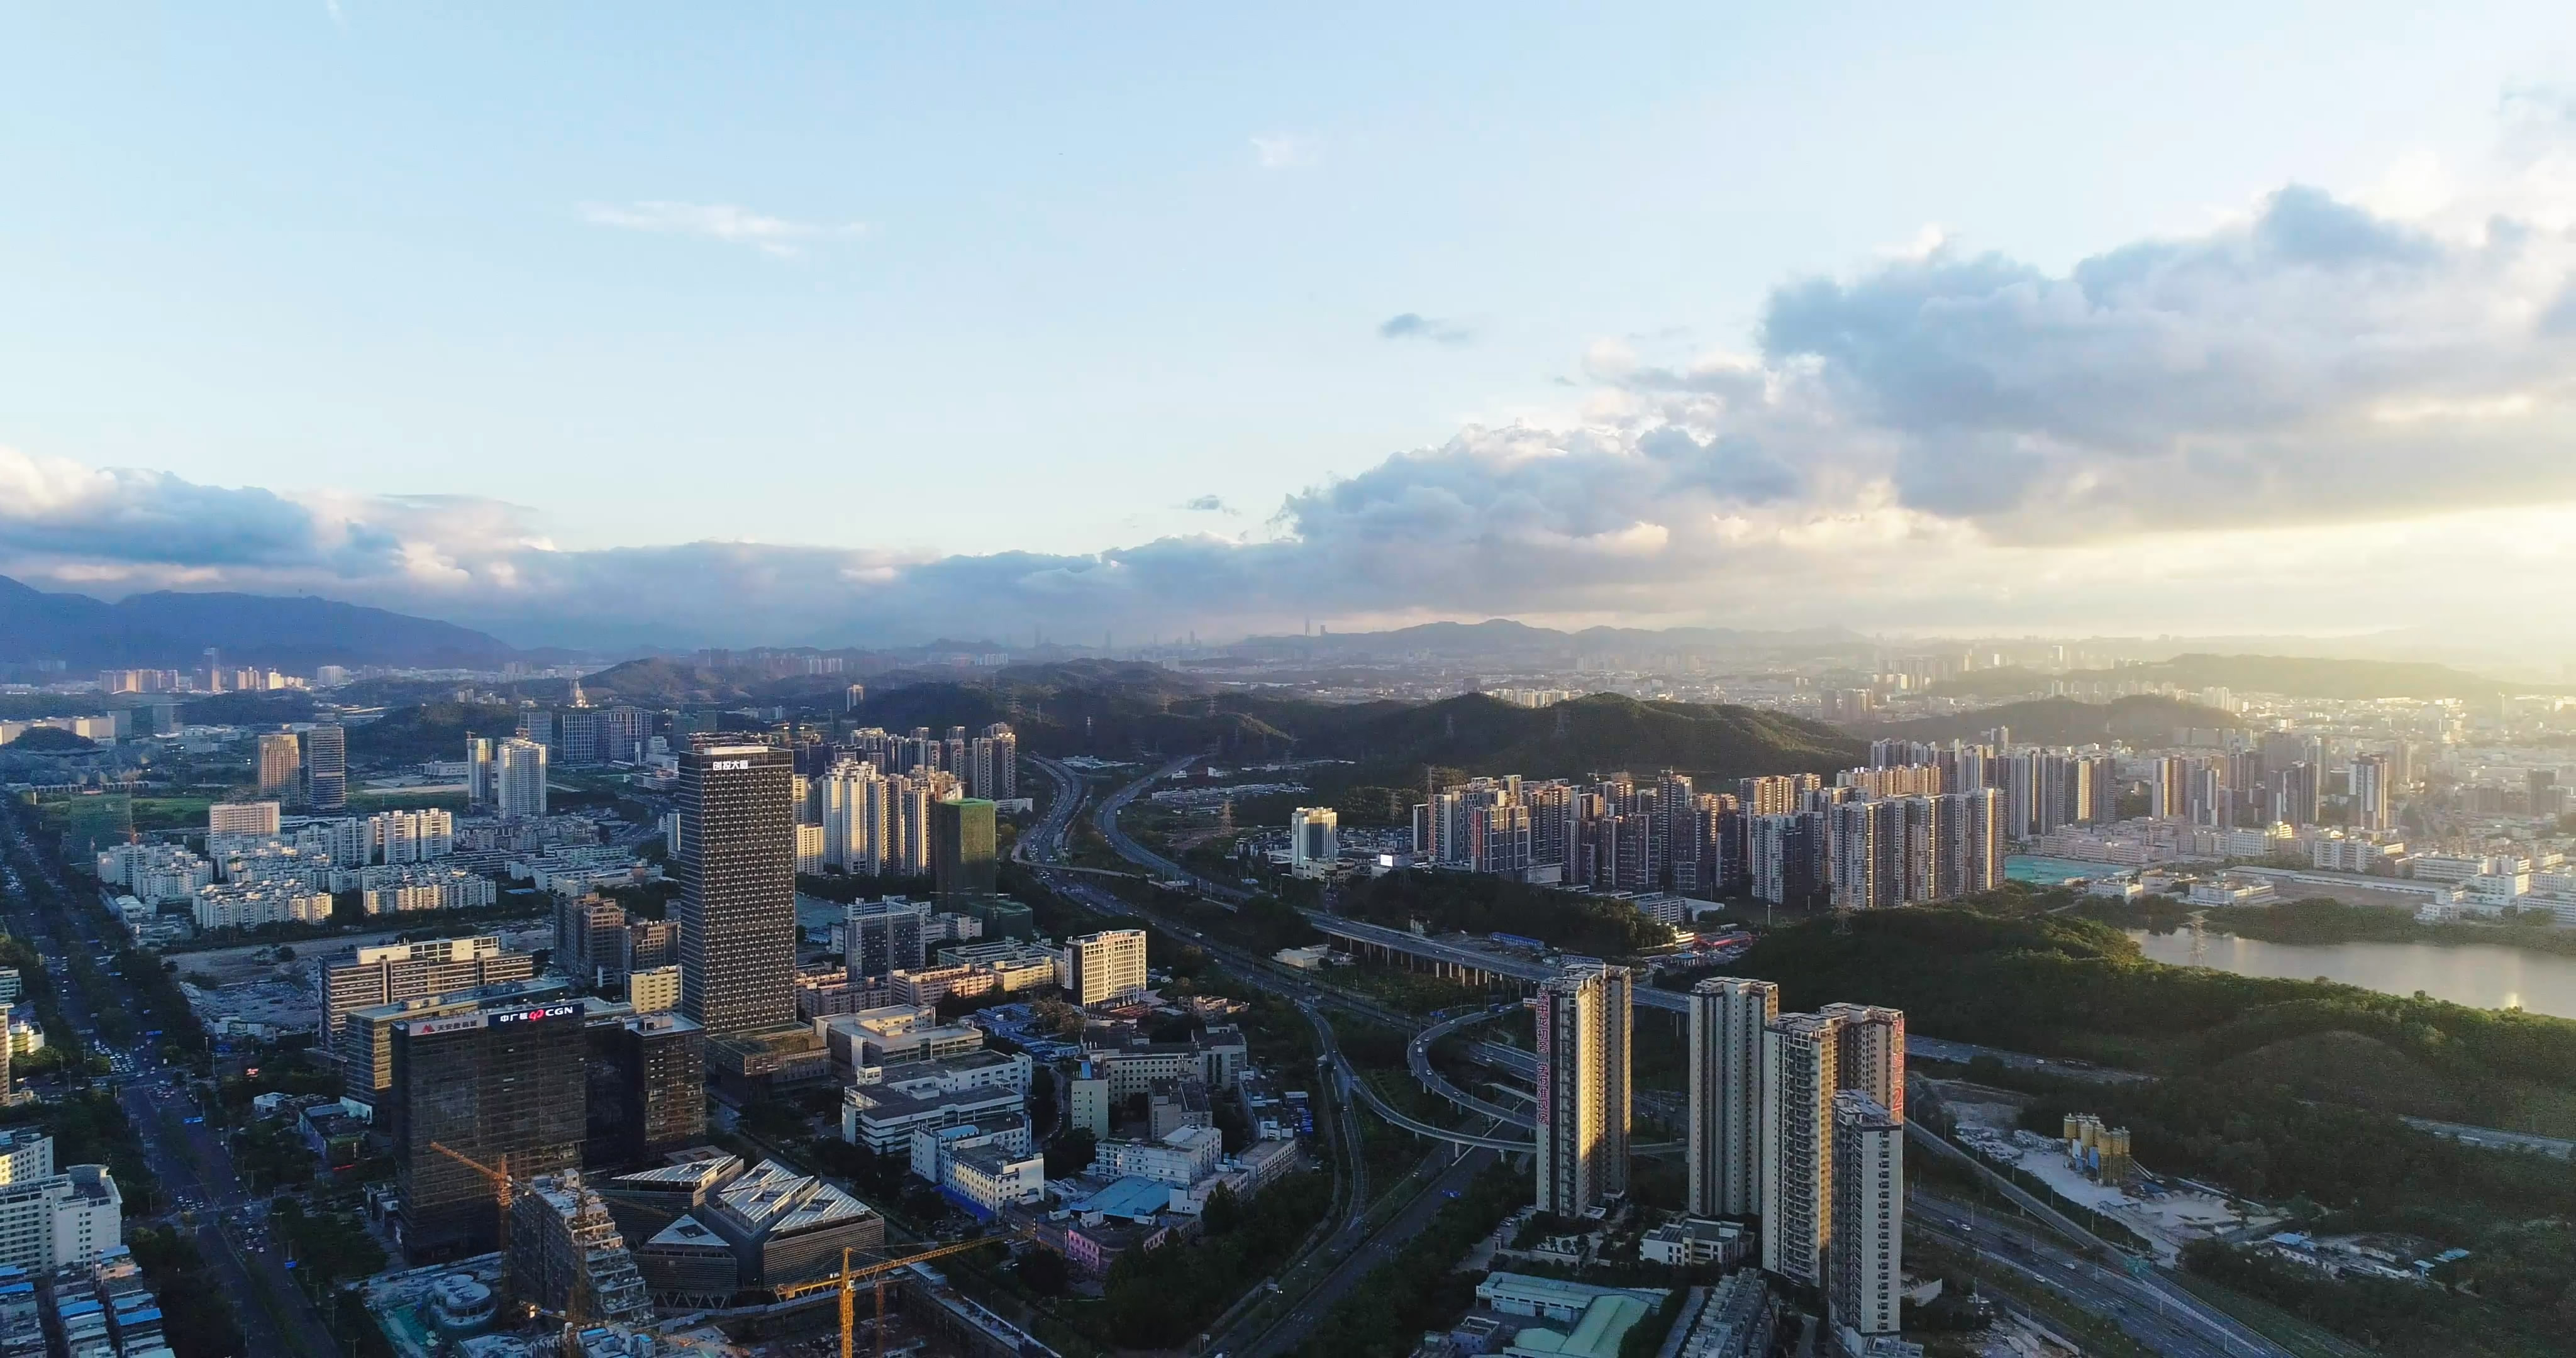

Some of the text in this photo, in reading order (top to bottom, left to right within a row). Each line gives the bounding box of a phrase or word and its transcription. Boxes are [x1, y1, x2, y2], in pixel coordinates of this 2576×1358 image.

[713, 760, 748, 771] 创投大厦
[500, 1012, 528, 1022] 中广核
[545, 1007, 574, 1017] CGN
